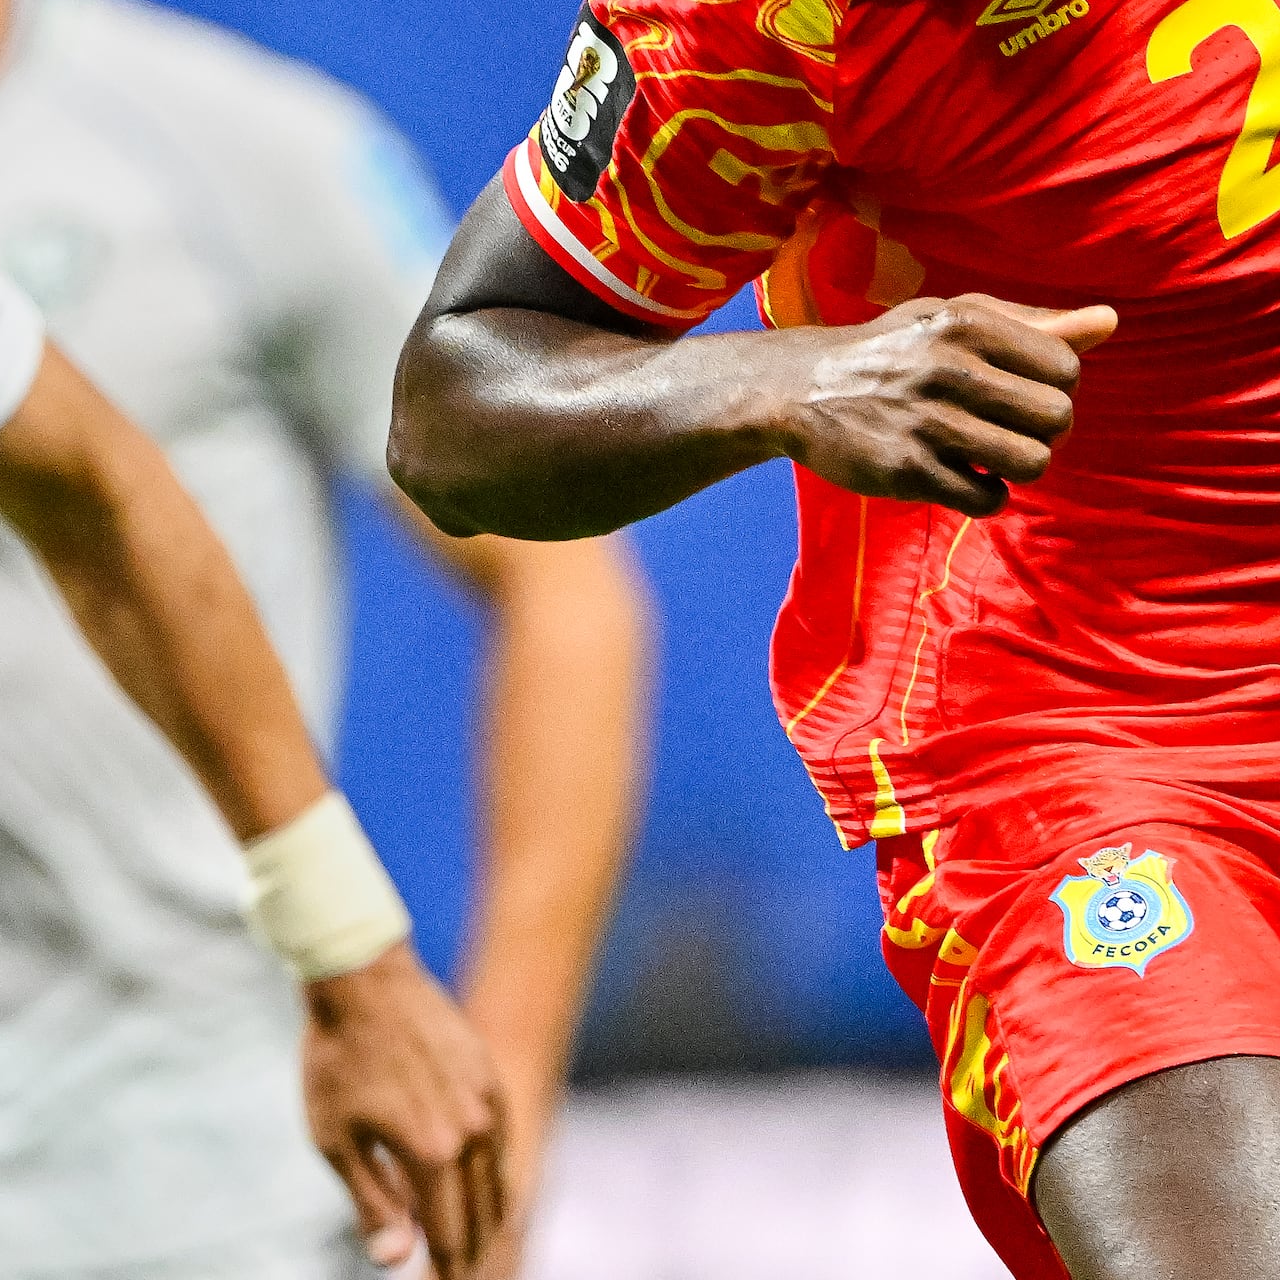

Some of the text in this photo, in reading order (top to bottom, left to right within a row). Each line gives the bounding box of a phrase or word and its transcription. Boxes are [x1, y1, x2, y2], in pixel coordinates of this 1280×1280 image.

[556, 99, 574, 128] FIFA
[556, 136, 576, 157] CUP
[1092, 924, 1172, 958] FECOFA
